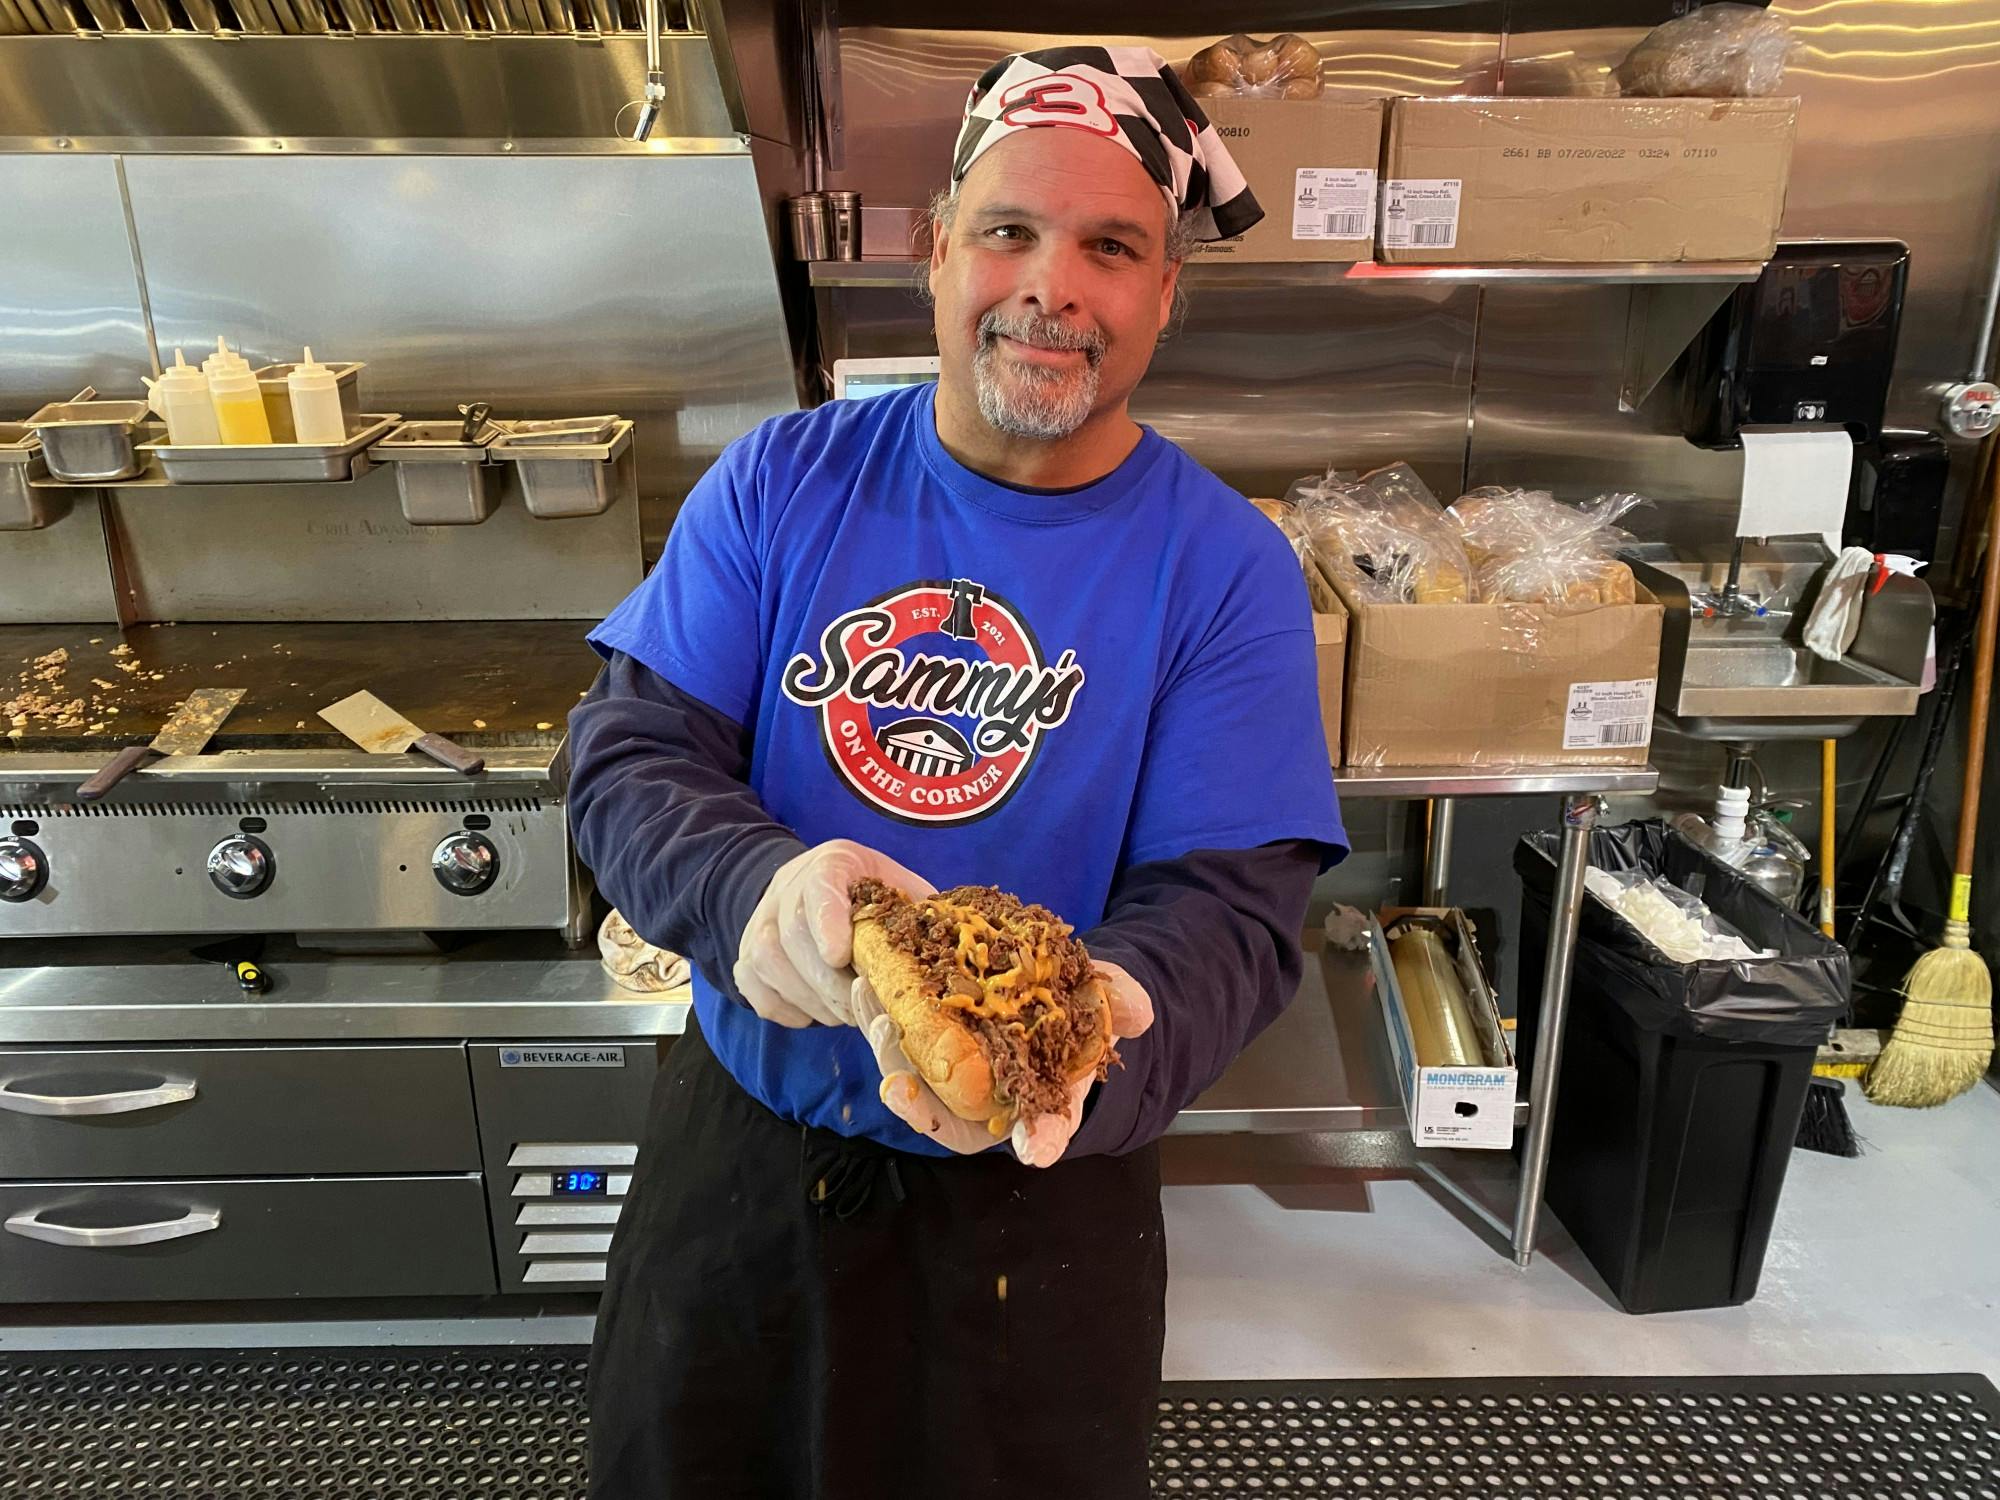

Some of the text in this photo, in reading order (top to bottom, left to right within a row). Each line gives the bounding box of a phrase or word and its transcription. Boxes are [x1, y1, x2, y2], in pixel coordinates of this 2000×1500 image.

[1000, 73, 1119, 136] 3
[1216, 128, 1250, 136] 00810
[1502, 148, 1717, 158] 2661 BB 07/20/2022 03:24 07110
[1964, 390, 1996, 401] PULL
[911, 607, 941, 621] EST.
[981, 621, 1005, 646] 2021
[783, 608, 1084, 753] Sammy's
[839, 719, 1004, 806] ON THE CORNER
[523, 1052, 618, 1062] BEVERAGE-AIR
[1427, 1073, 1505, 1086] MONOGRAM
